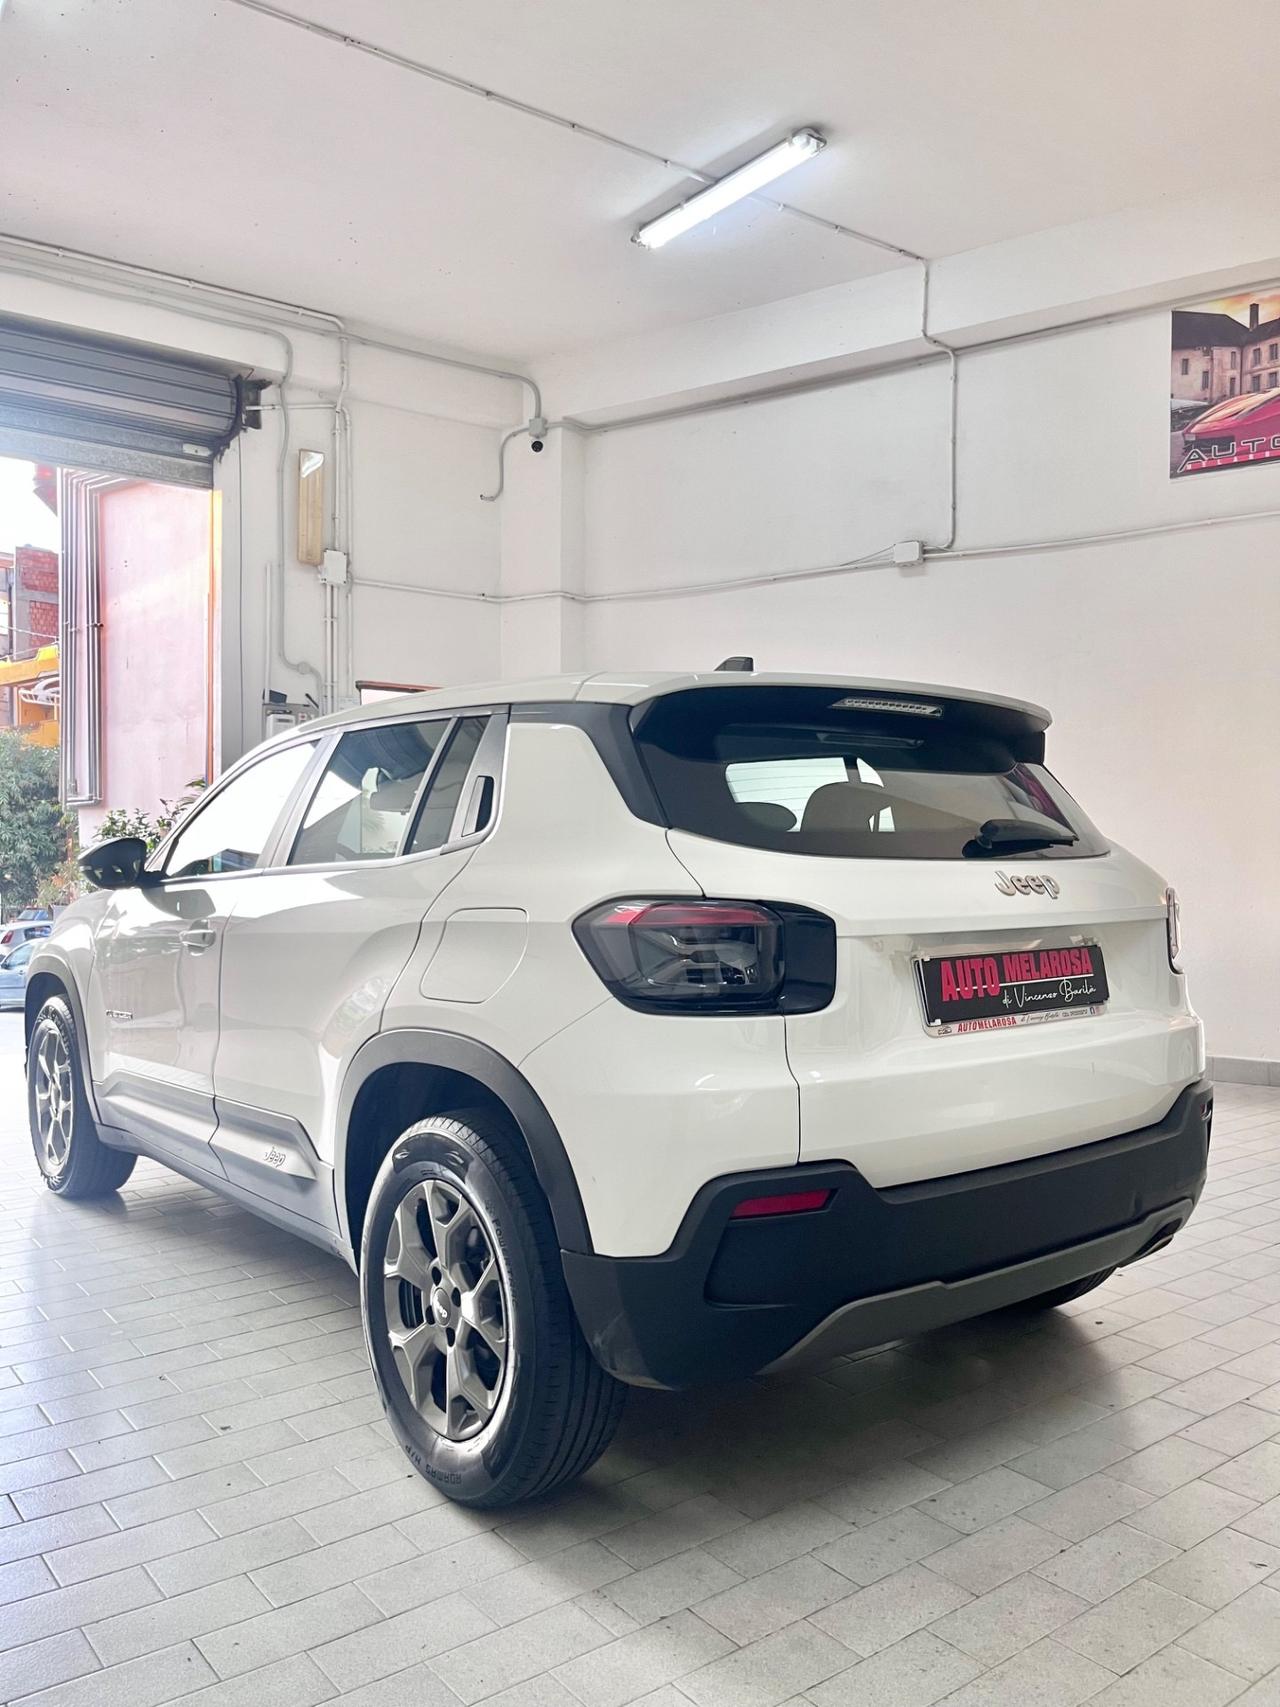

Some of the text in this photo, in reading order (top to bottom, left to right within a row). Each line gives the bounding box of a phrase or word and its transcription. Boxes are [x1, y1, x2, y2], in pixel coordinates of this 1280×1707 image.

[994, 870, 1060, 900] Jeep
[941, 948, 1093, 1001] AUTO MELAROSA
[1002, 989, 1012, 1008] di
[264, 1146, 286, 1168] Jeep
